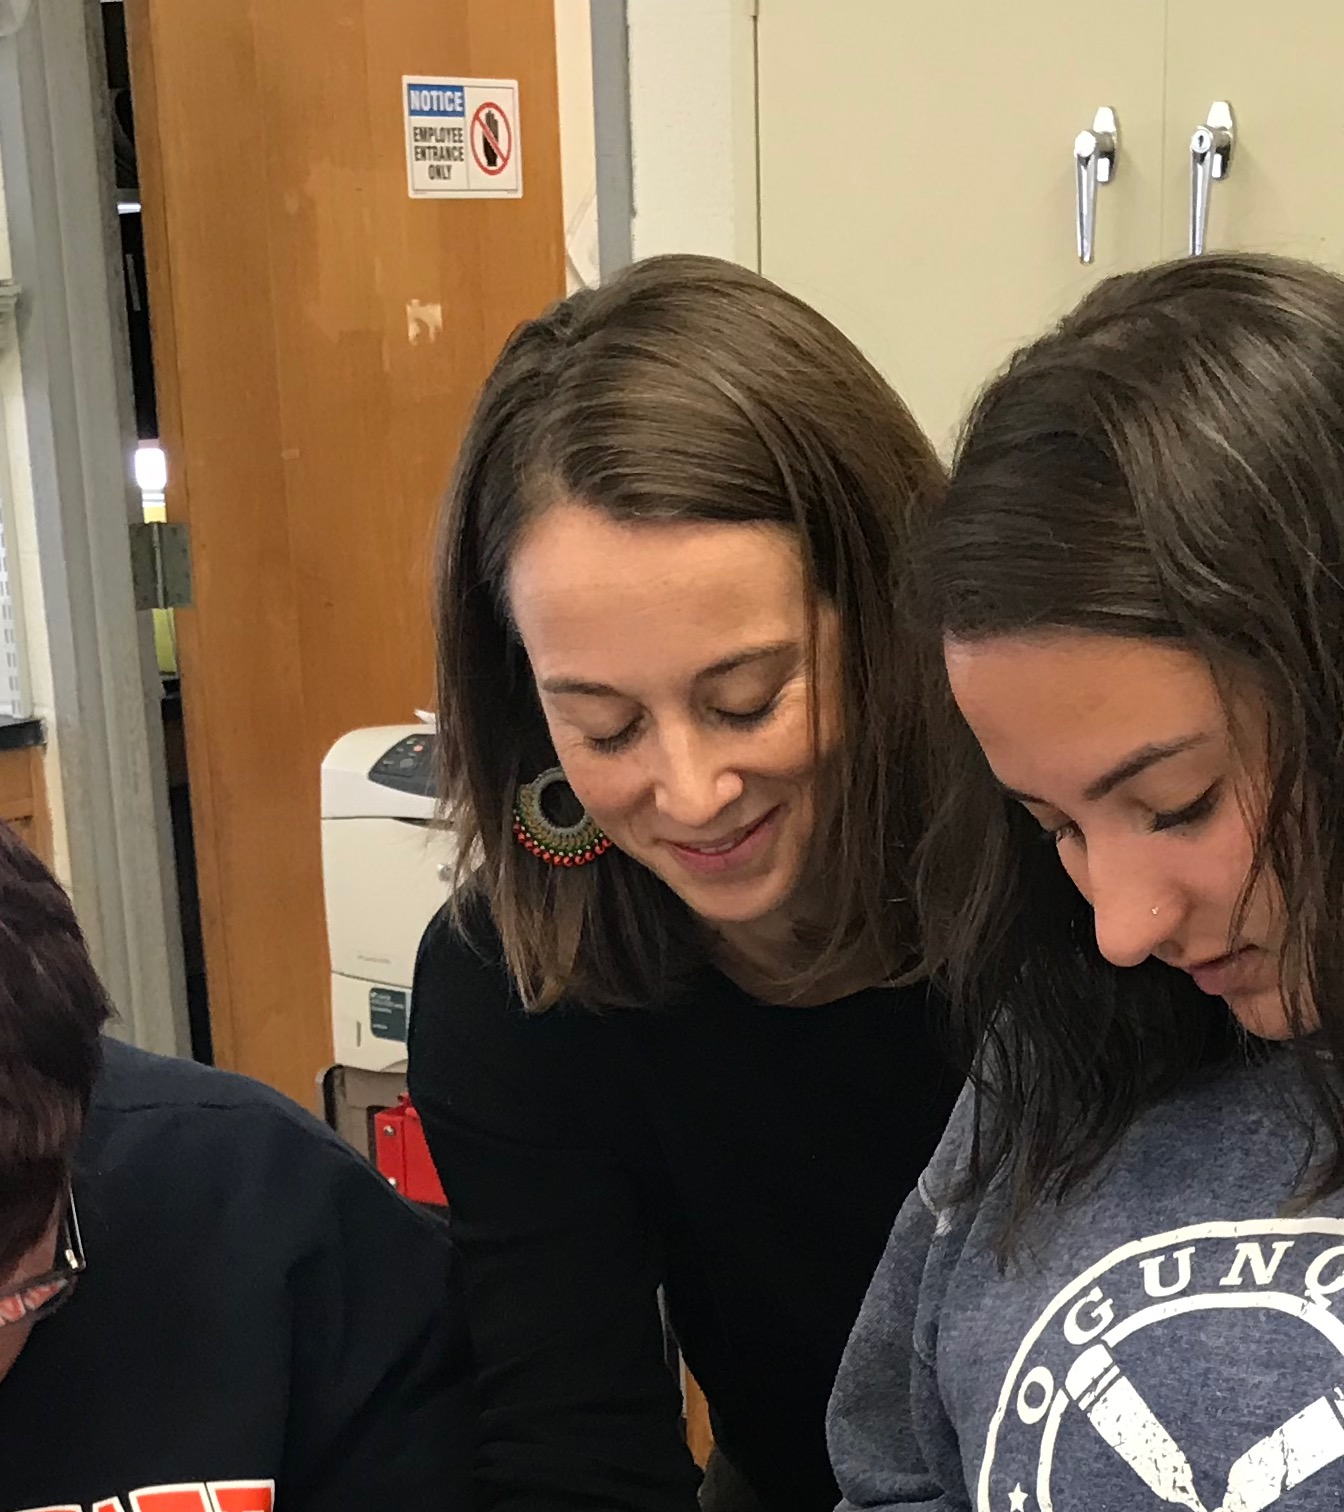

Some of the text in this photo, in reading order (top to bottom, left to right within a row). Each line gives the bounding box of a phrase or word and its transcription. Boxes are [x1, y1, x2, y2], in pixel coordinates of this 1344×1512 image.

[409, 89, 464, 112] NOTICE
[412, 126, 464, 144] EMPLOYEE
[414, 145, 465, 162] ENTRANCE
[427, 164, 453, 180] ONLY
